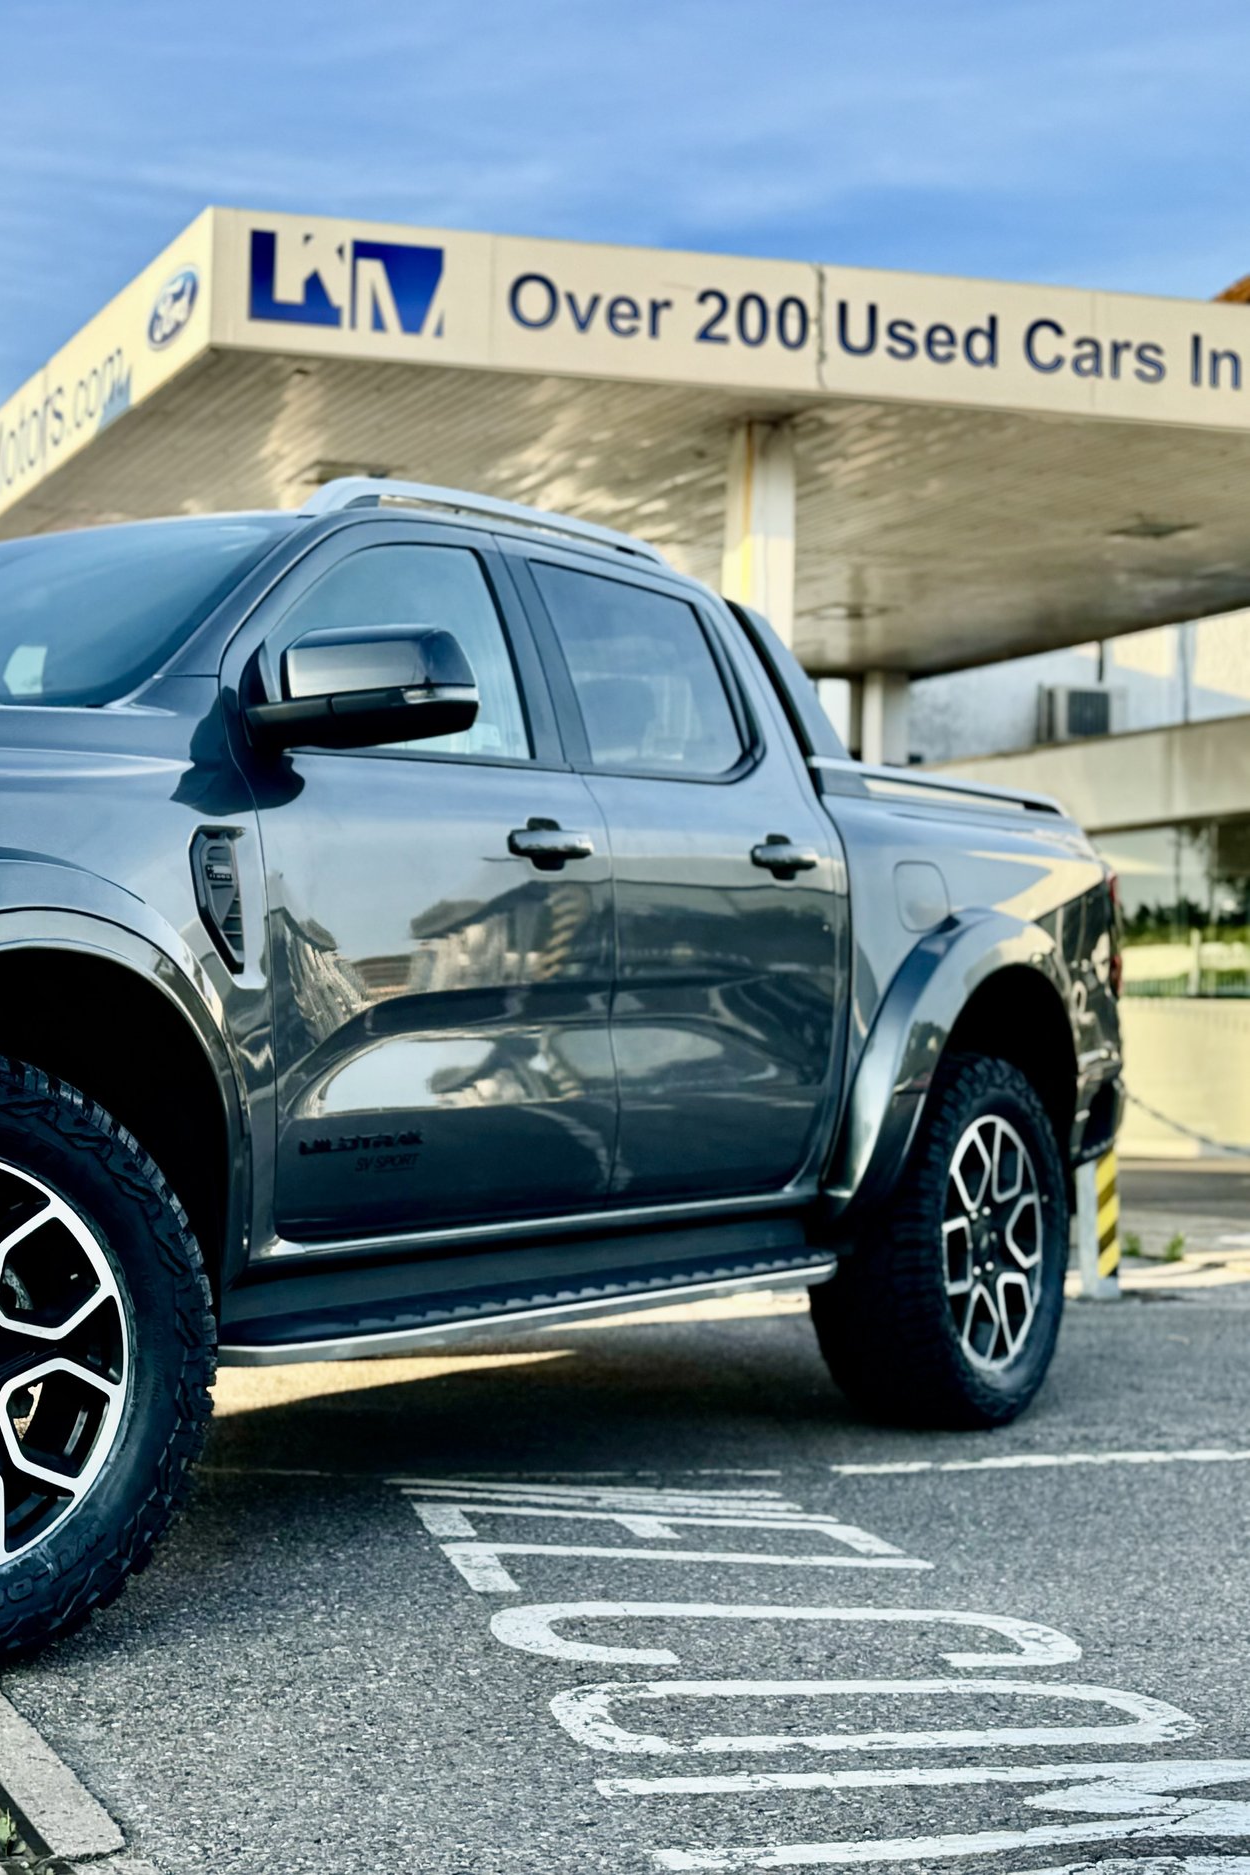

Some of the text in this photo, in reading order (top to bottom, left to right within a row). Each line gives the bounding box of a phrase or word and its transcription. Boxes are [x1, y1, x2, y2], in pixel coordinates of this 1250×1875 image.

[507, 271, 1242, 390] Over 200 Used Cars In
[383, 1478, 1250, 1875] WELCOM
